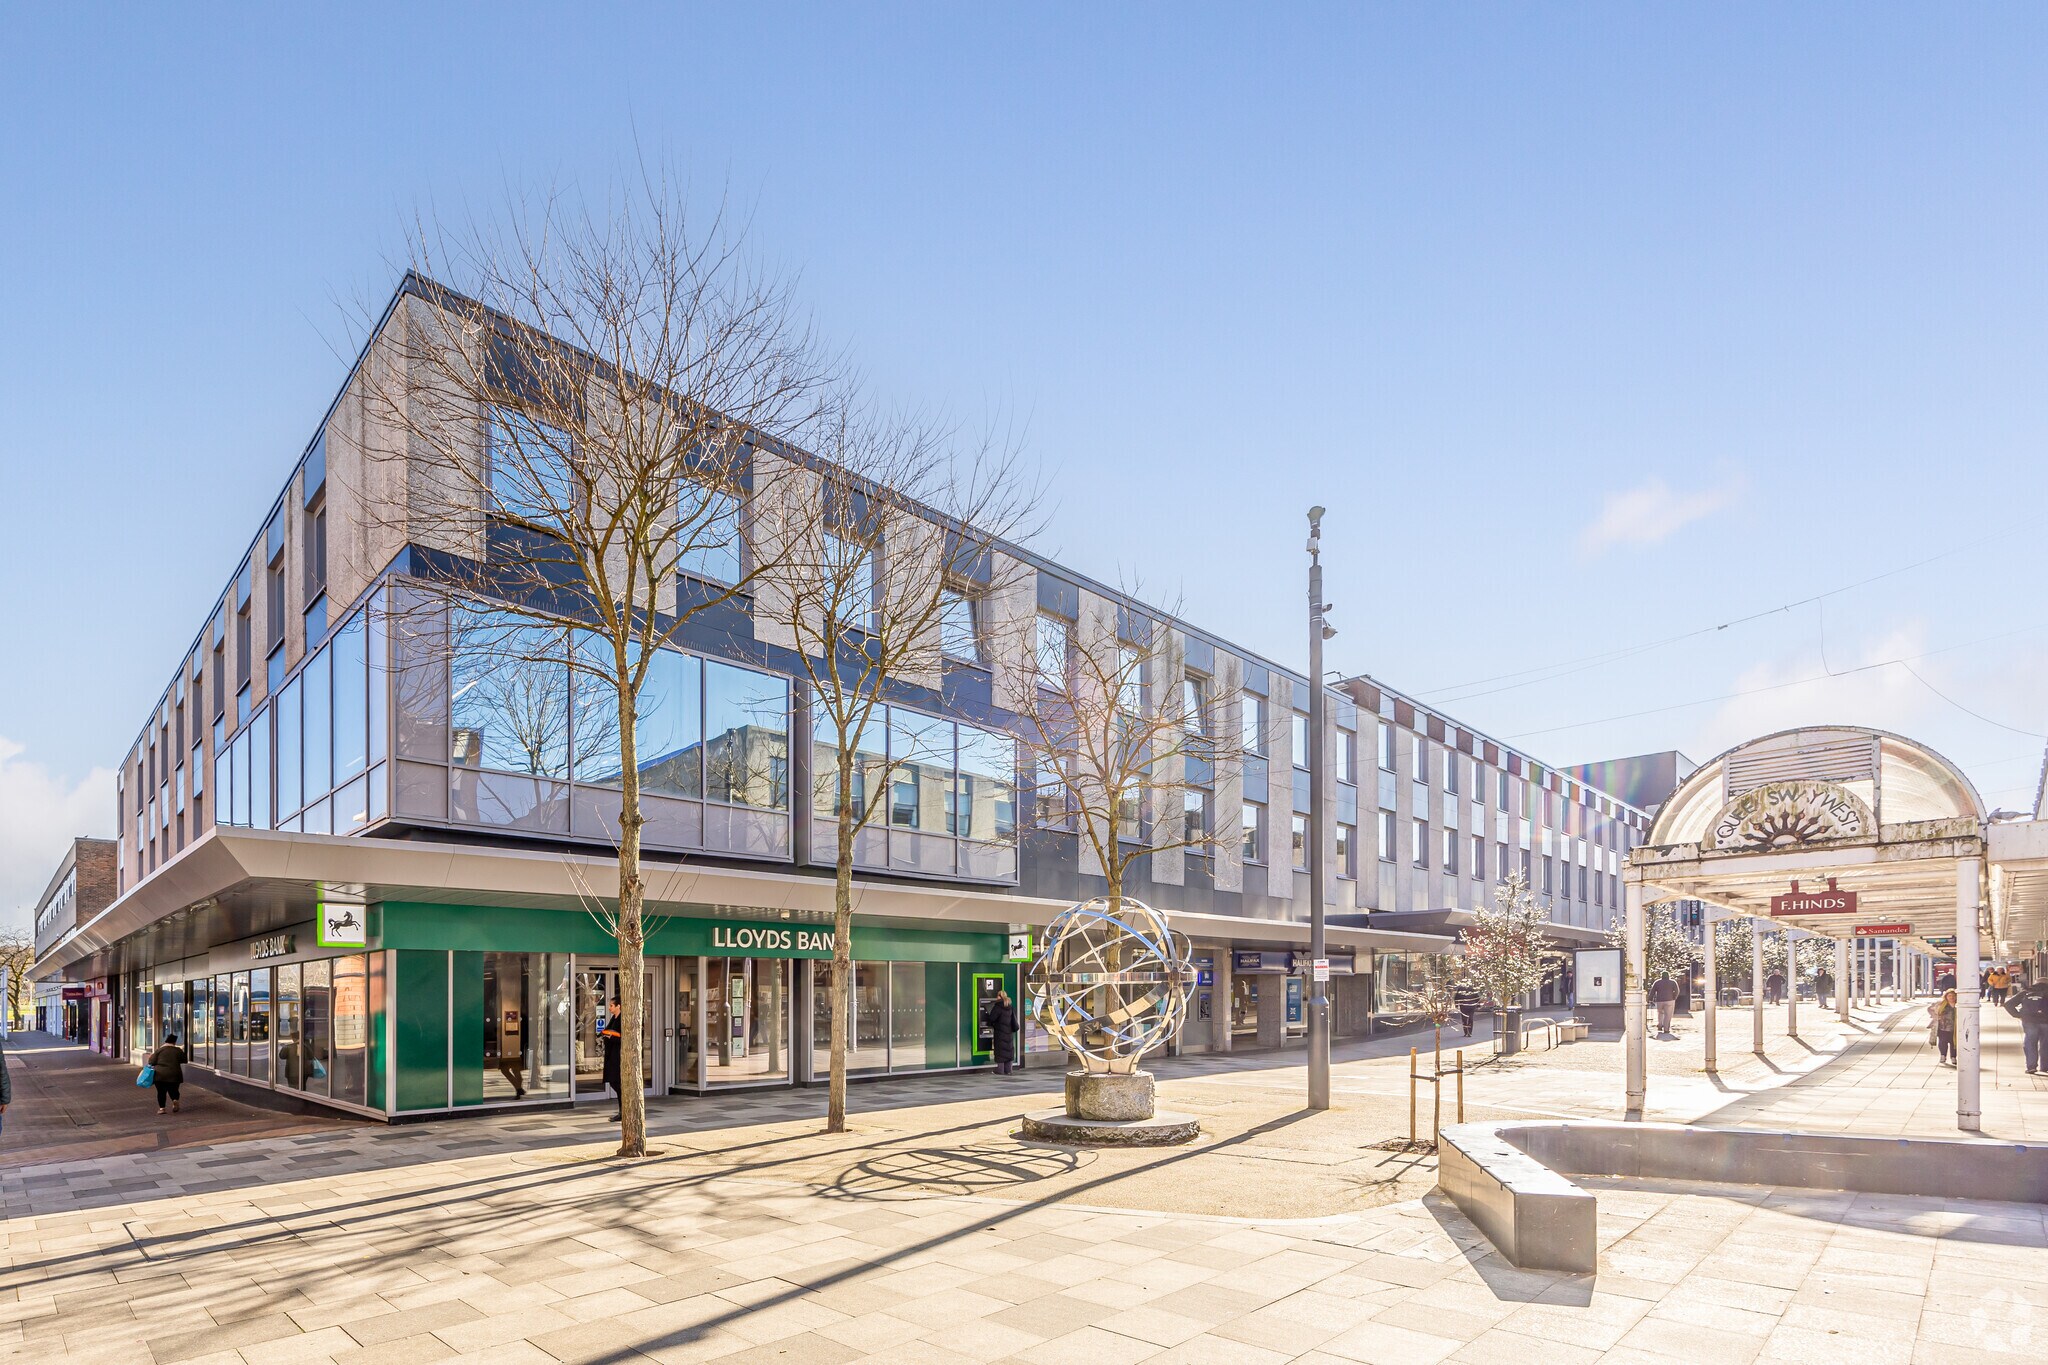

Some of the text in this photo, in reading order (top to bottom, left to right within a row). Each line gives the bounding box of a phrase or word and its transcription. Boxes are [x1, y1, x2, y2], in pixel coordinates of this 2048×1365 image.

[1716, 788, 1861, 838] QUEESWY WEST
[1781, 897, 1846, 911] F.HINDS
[713, 927, 835, 951] LLOYDS BAN
[1868, 926, 1908, 934] Santander
